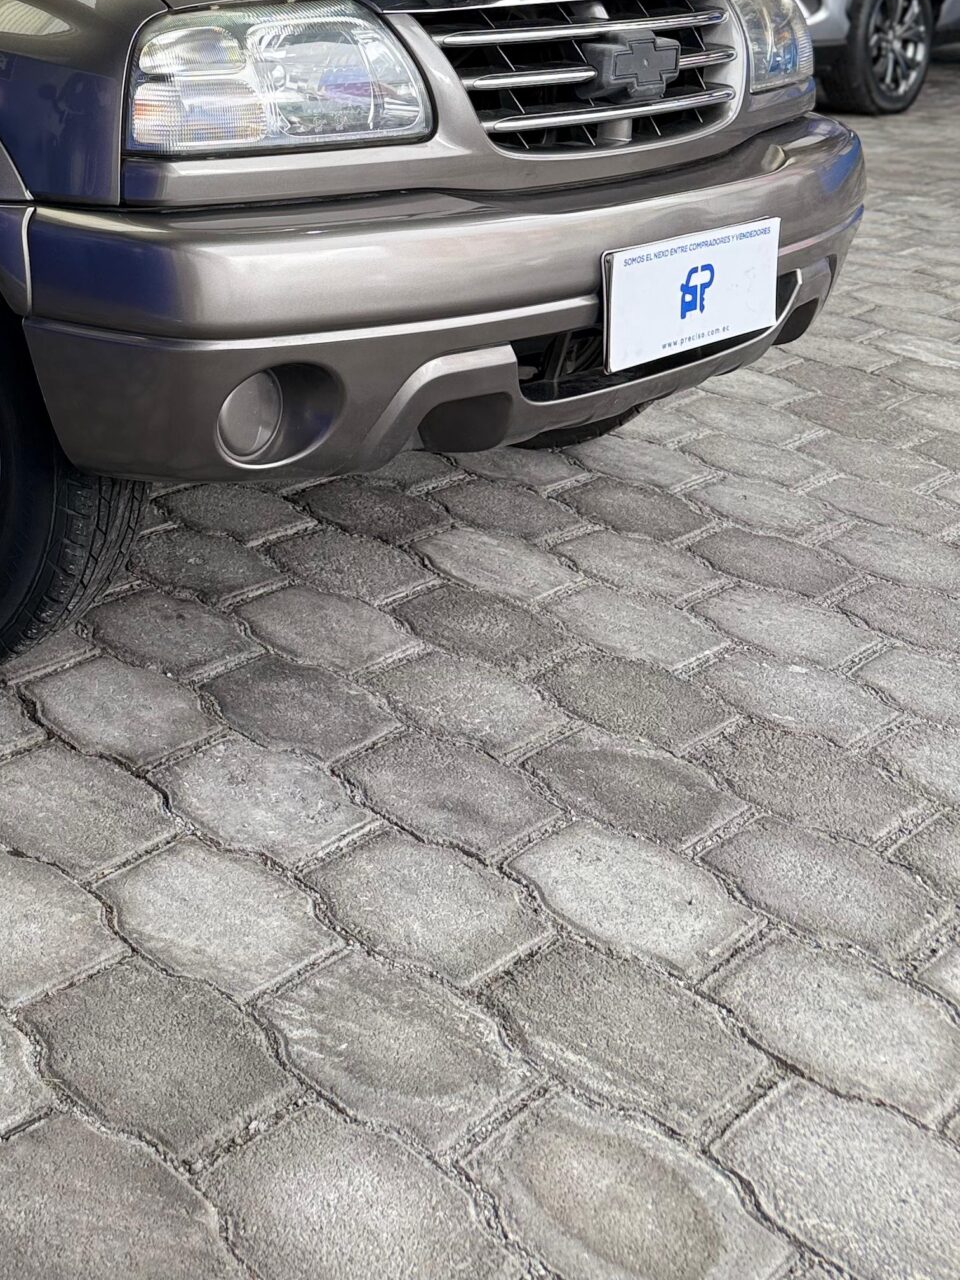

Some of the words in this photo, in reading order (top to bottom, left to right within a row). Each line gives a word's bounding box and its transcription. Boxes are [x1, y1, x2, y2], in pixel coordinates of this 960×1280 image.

[623, 255, 645, 267] SOMOS
[645, 253, 653, 262] EL
[670, 245, 688, 256] ENTRE
[688, 236, 730, 252] COMPRADORES
[735, 227, 771, 241] VENDEDORES
